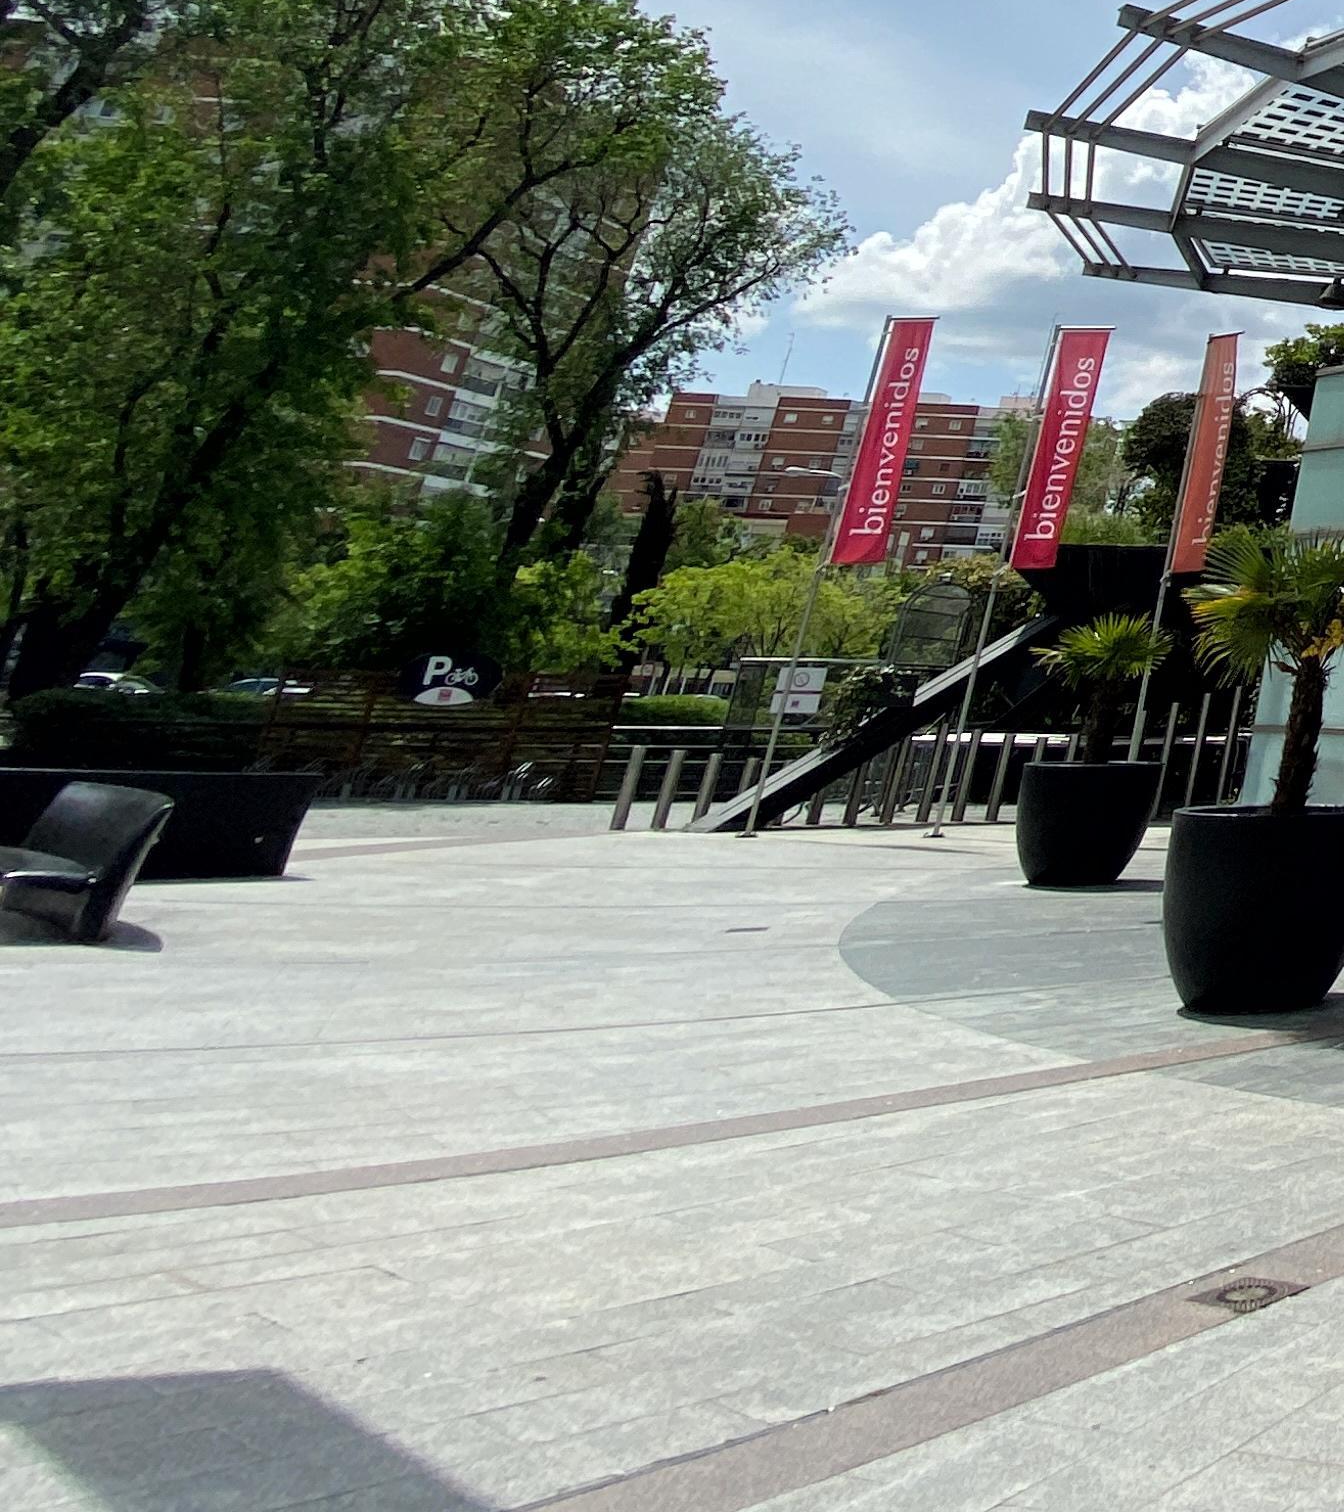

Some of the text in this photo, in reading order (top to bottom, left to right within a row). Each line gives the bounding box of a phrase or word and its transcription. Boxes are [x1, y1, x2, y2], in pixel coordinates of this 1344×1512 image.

[849, 347, 919, 536] bienvenidos
[1024, 357, 1095, 541] bienvenidos
[1192, 362, 1235, 546] bienvenidos
[422, 655, 453, 686] P
